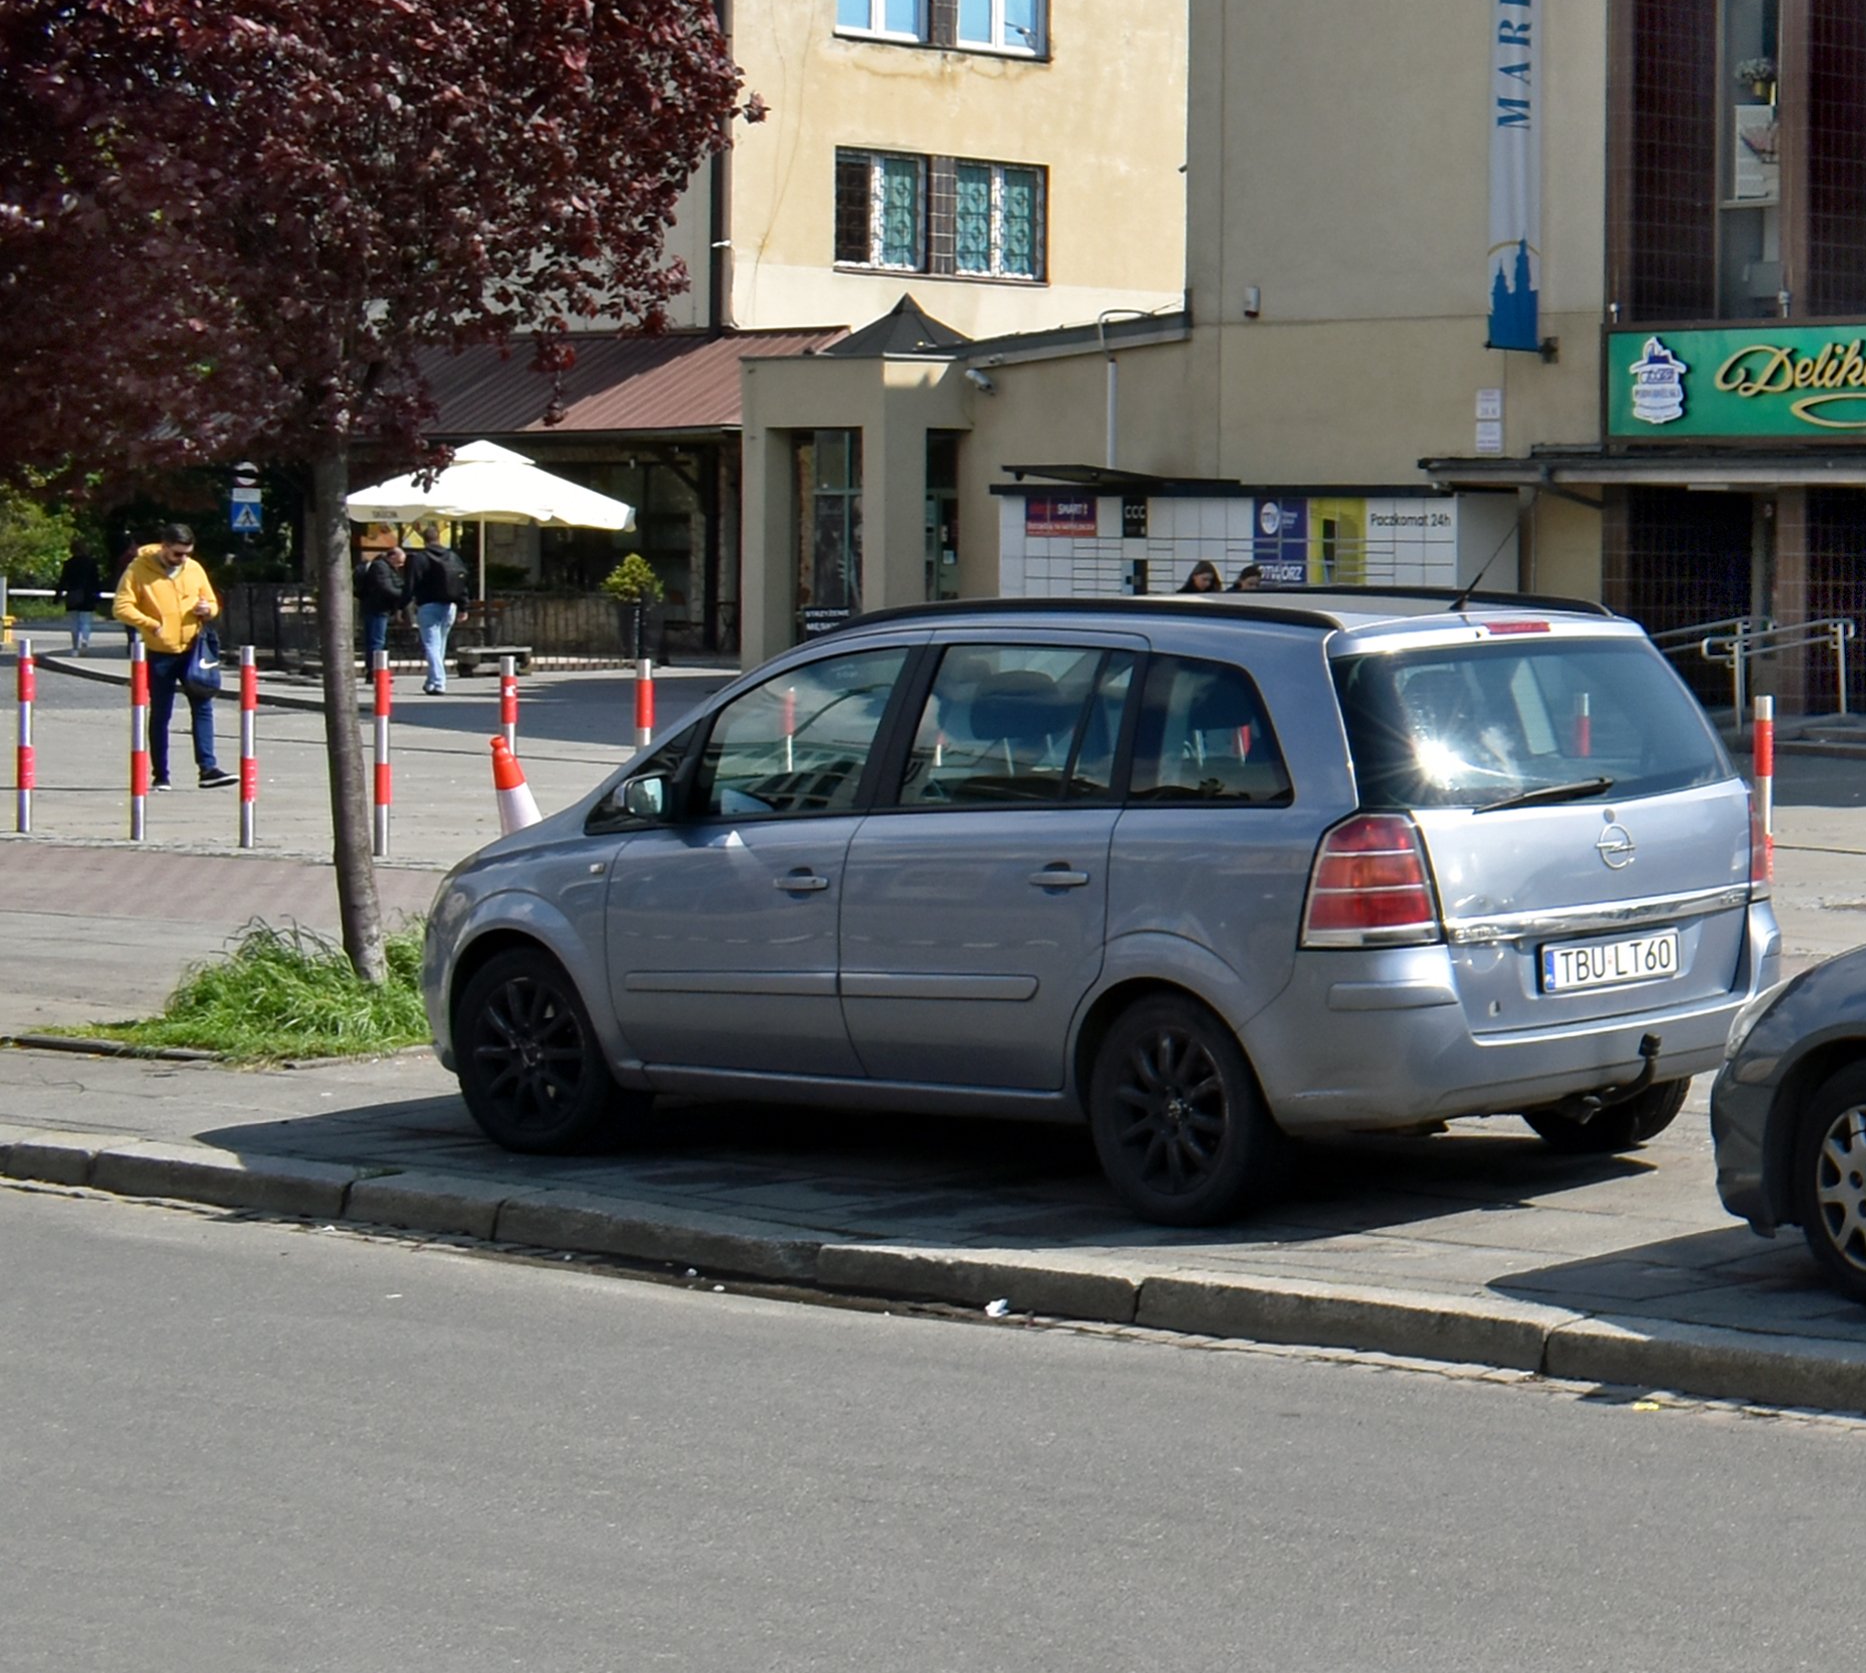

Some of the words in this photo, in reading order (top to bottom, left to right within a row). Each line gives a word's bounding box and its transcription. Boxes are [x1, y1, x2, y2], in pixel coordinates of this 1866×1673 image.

[1124, 505, 1146, 519] CCC
[1370, 513, 1428, 527] Paczkomat
[1431, 513, 1451, 527] 24h
[1560, 945, 1606, 983] TBU
[1614, 938, 1671, 976] LT60
